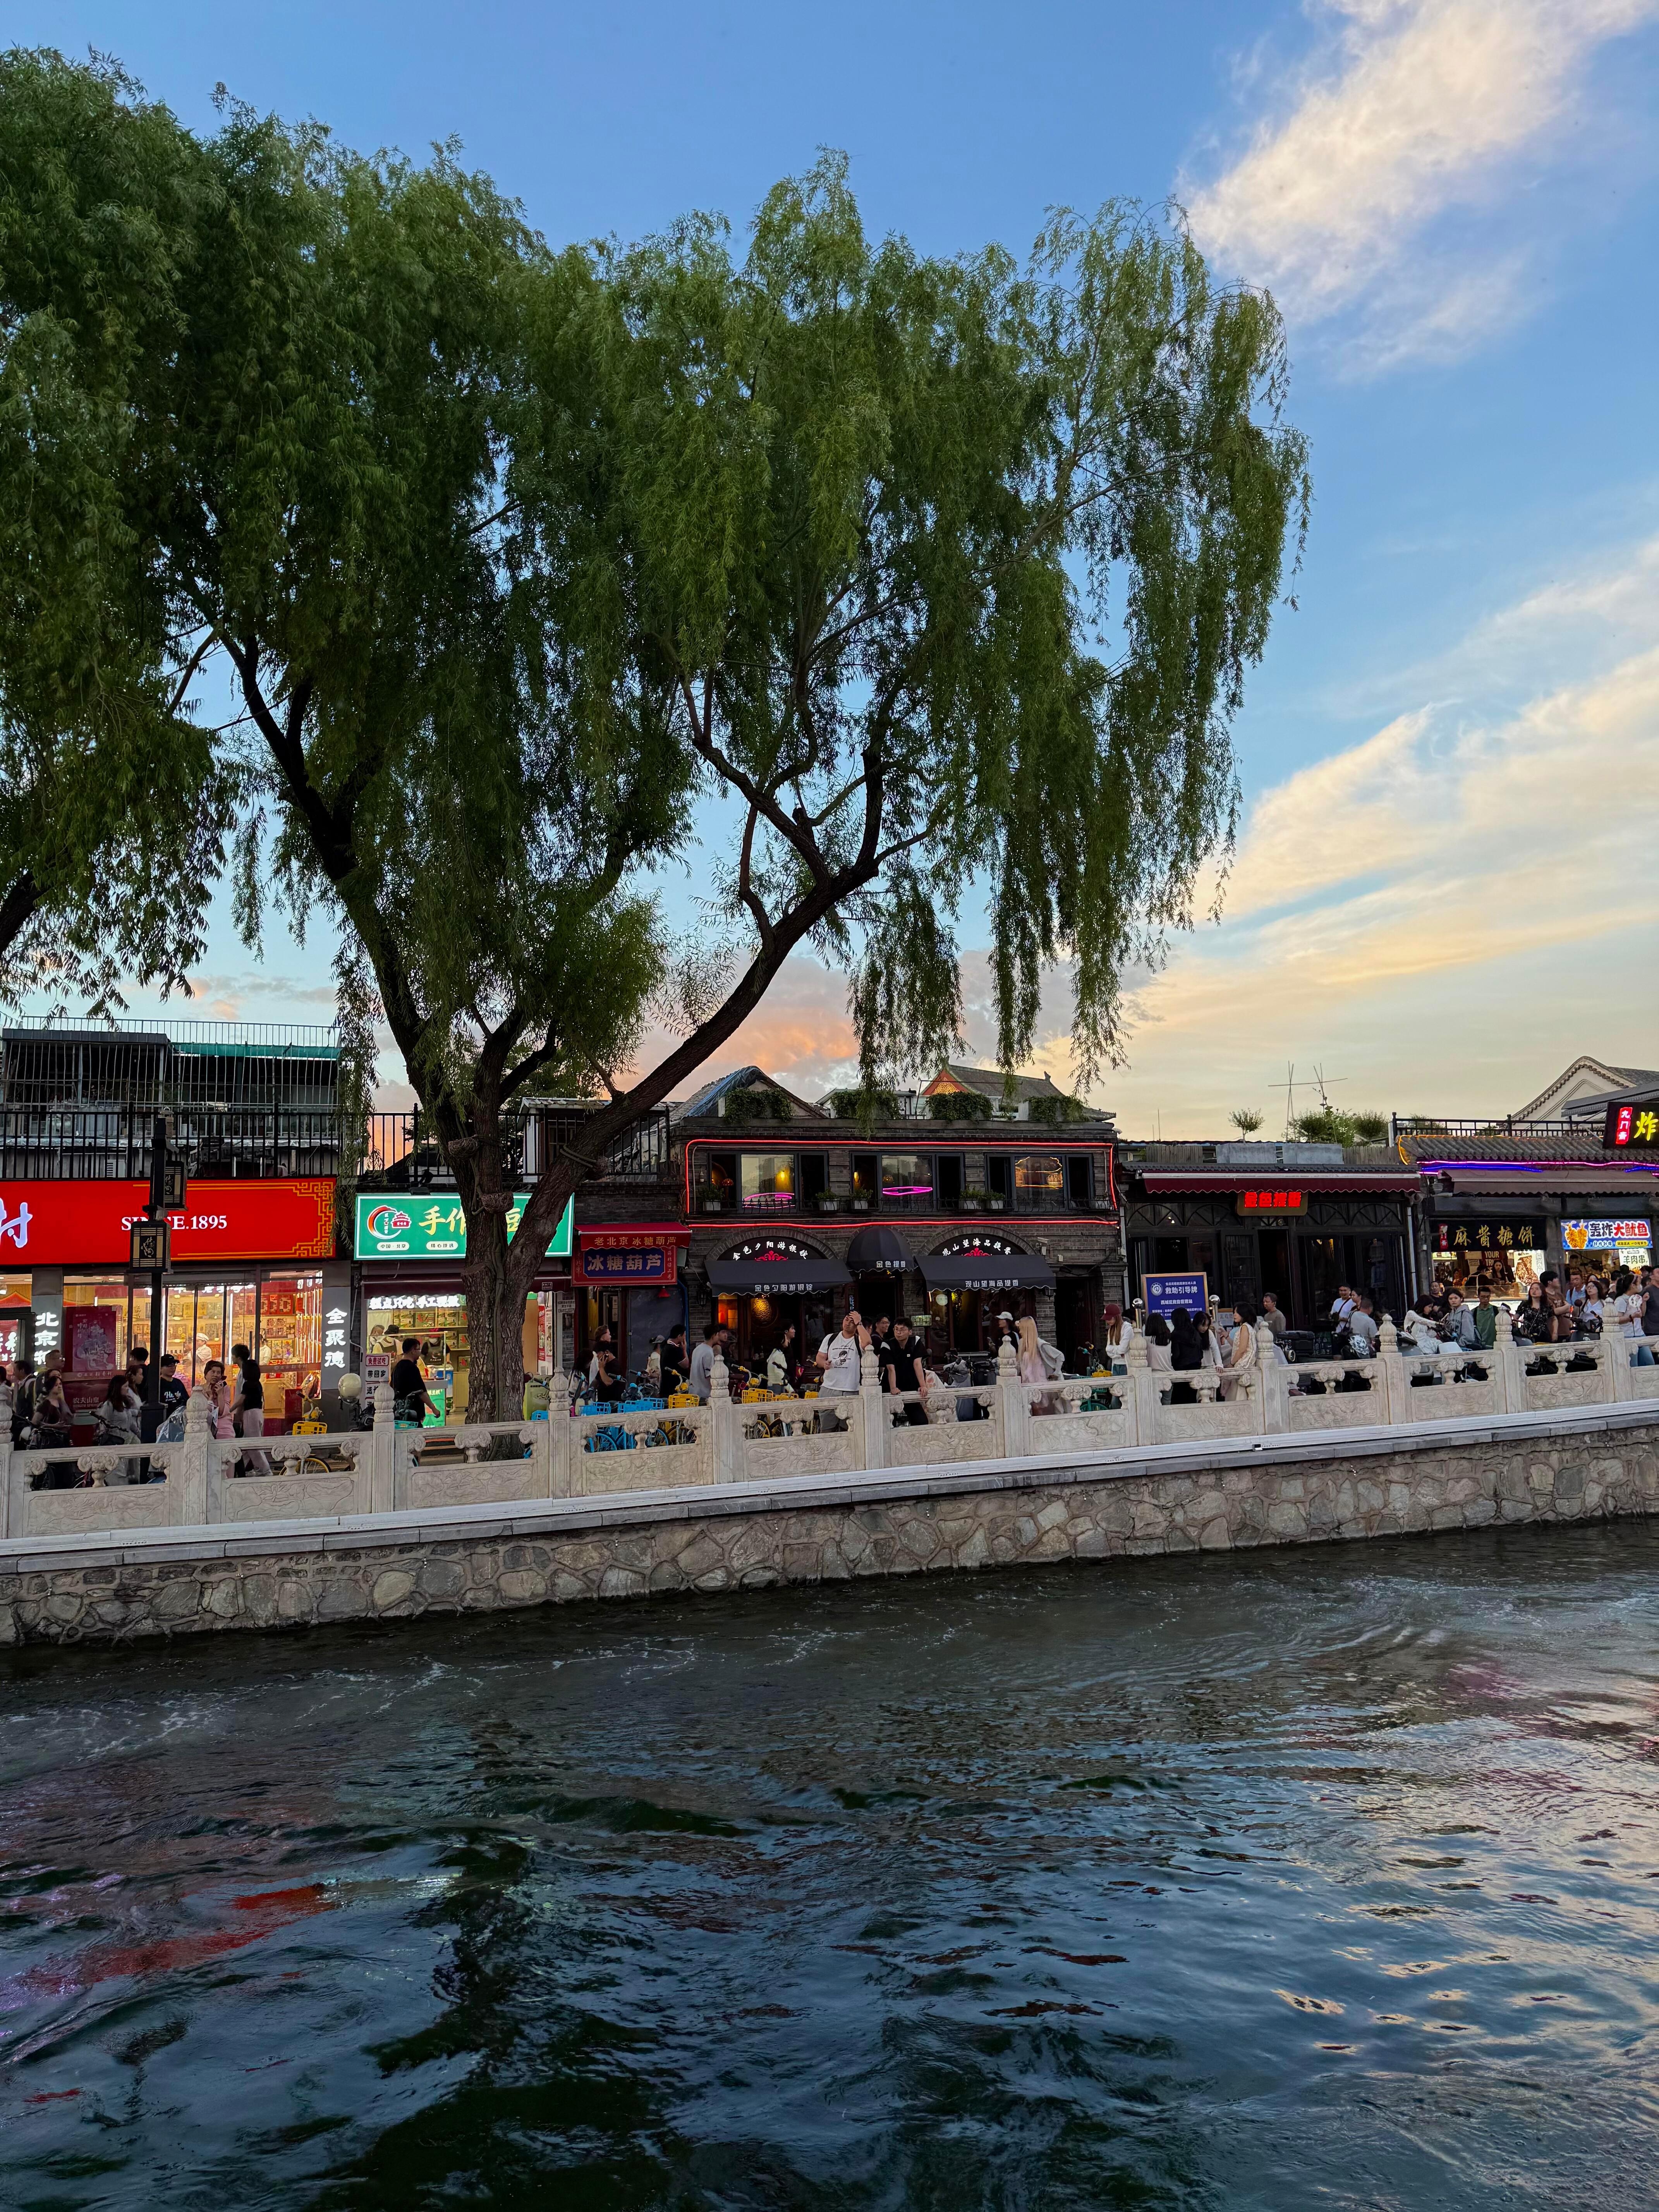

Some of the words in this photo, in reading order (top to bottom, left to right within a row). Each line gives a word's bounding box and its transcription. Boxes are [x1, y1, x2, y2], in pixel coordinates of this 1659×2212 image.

[1634, 1112, 1659, 1141] 炸
[121, 1215, 227, 1231] SE.1895
[1590, 1223, 1648, 1237] 轰炸大鱿鱼
[594, 1237, 676, 1245] 老北京冰糖葫芦
[587, 1254, 661, 1271] 冰糖葫芦
[1623, 1255, 1645, 1264] 羊肉串
[755, 1283, 813, 1292] 金色夕阳游银锭
[1165, 1286, 1197, 1294] 救助引导牌
[325, 1308, 347, 1368] 全聚德
[368, 1370, 386, 1379] 带回家
